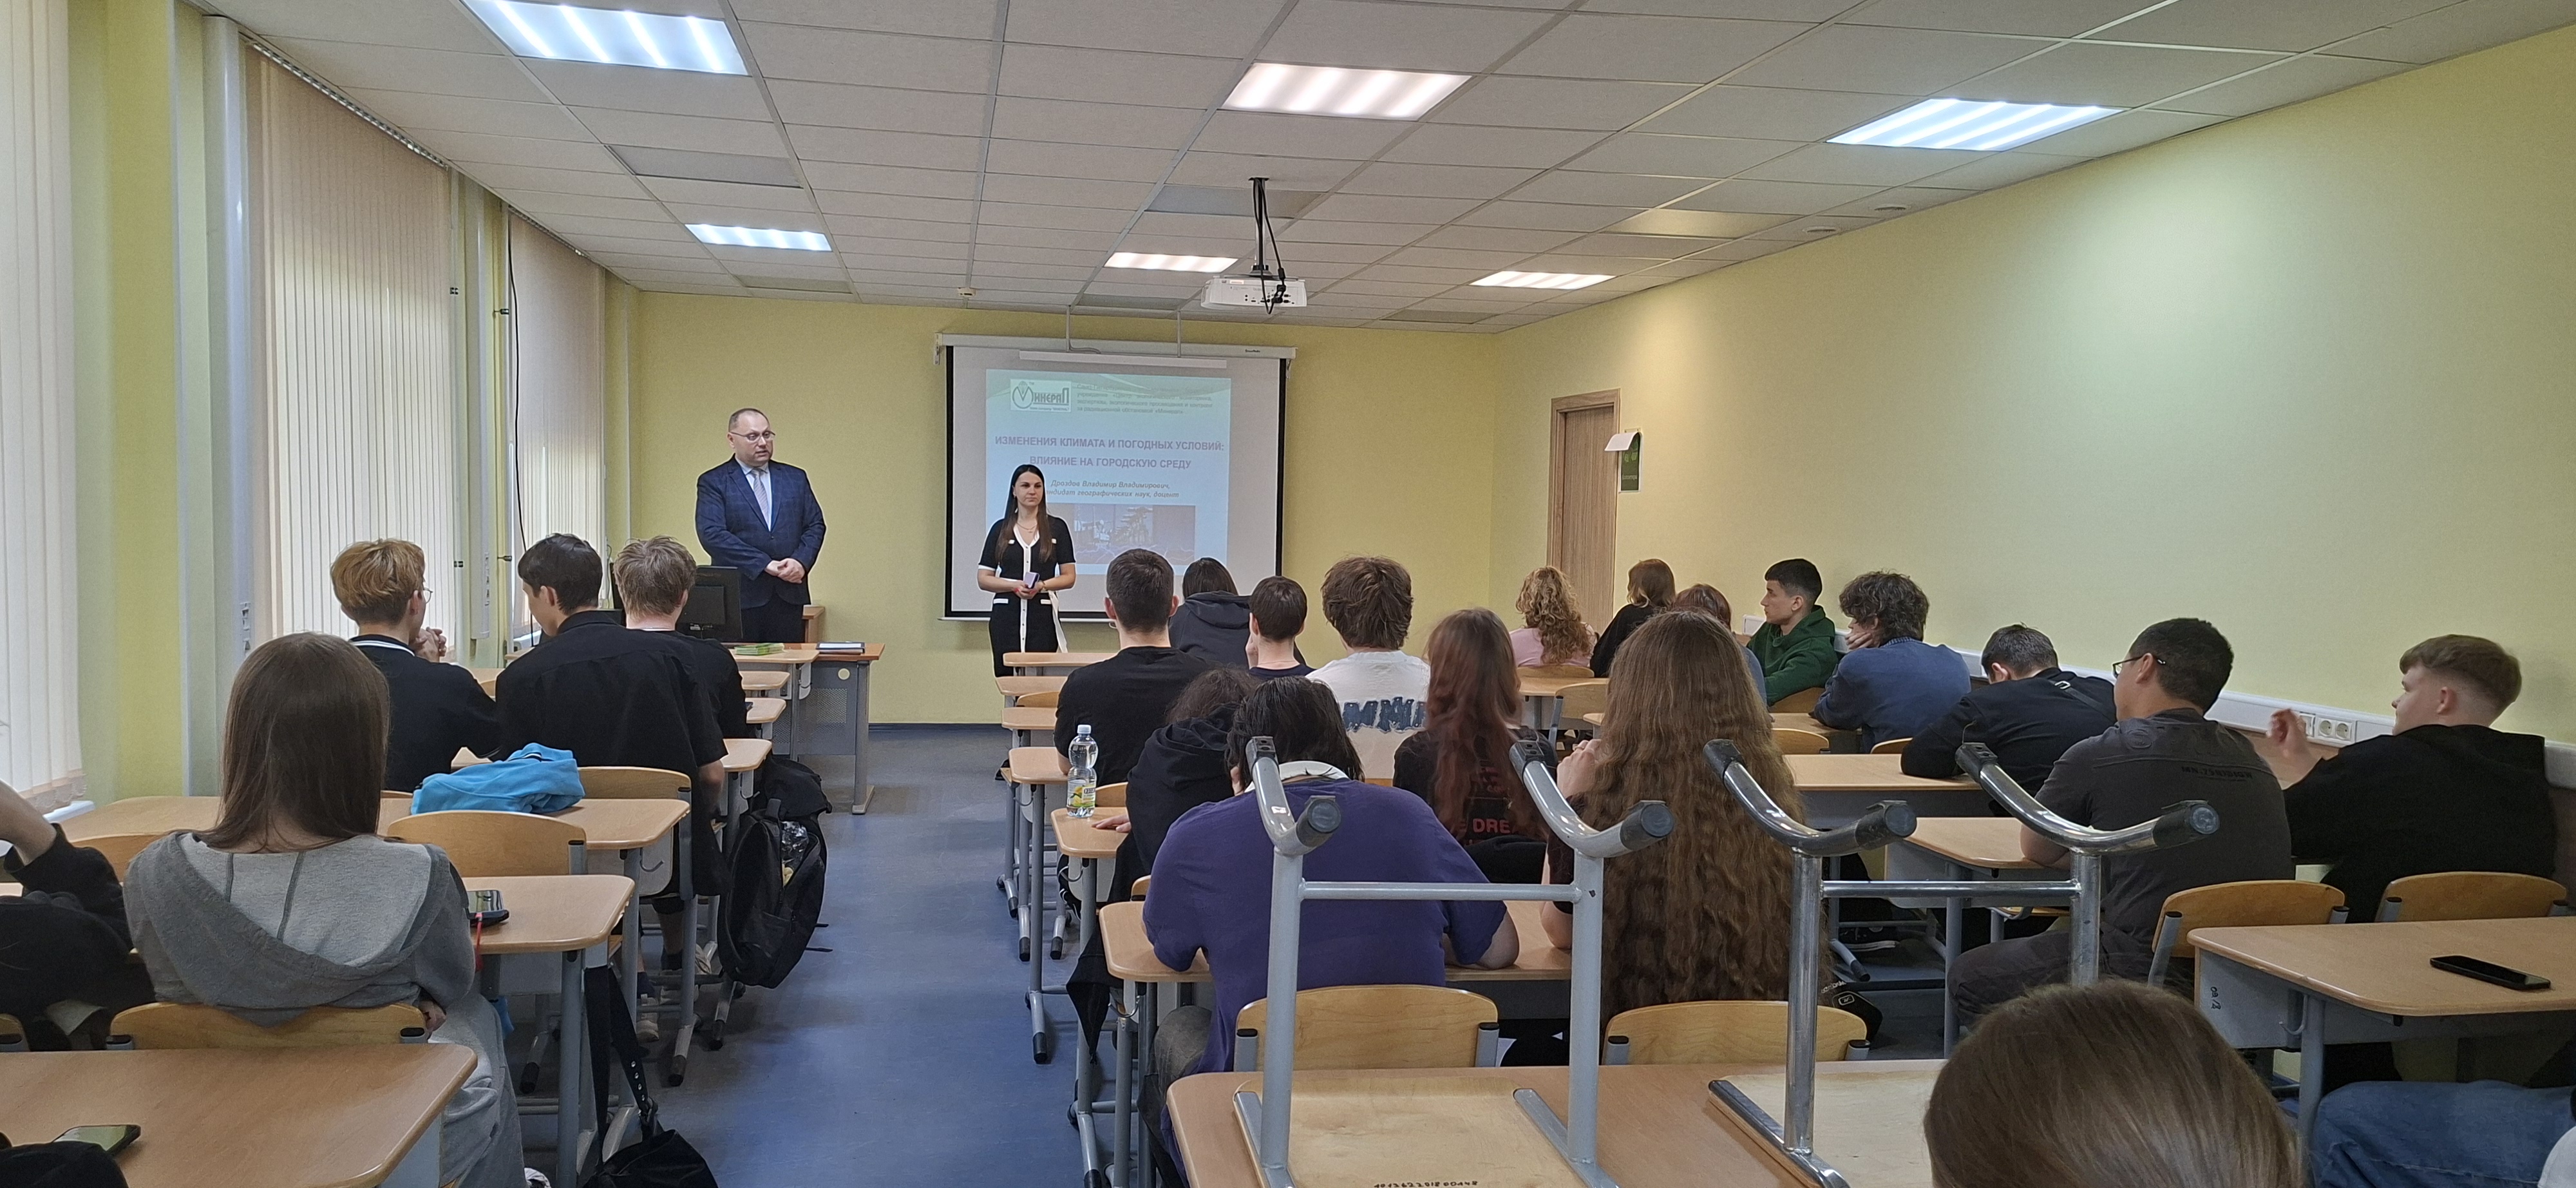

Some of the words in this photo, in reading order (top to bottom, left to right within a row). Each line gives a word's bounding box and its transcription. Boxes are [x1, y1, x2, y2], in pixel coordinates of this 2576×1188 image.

[995, 436, 1057, 446] ИЗМЕНЕНИЯ
[1060, 438, 1106, 448] КЛИМАТА
[1108, 439, 1115, 448] И
[1118, 440, 1173, 450] ПОГОДНЫХ
[1176, 441, 1224, 451] УСЛОВИЙ:
[1030, 456, 1077, 466] ВЛИЯНИЕ
[1080, 458, 1094, 466] НА
[1096, 458, 1157, 468] ГОРОДСКУЮ
[1160, 459, 1191, 470] СРЕДУ
[1119, 481, 1170, 490] Владимирович,
